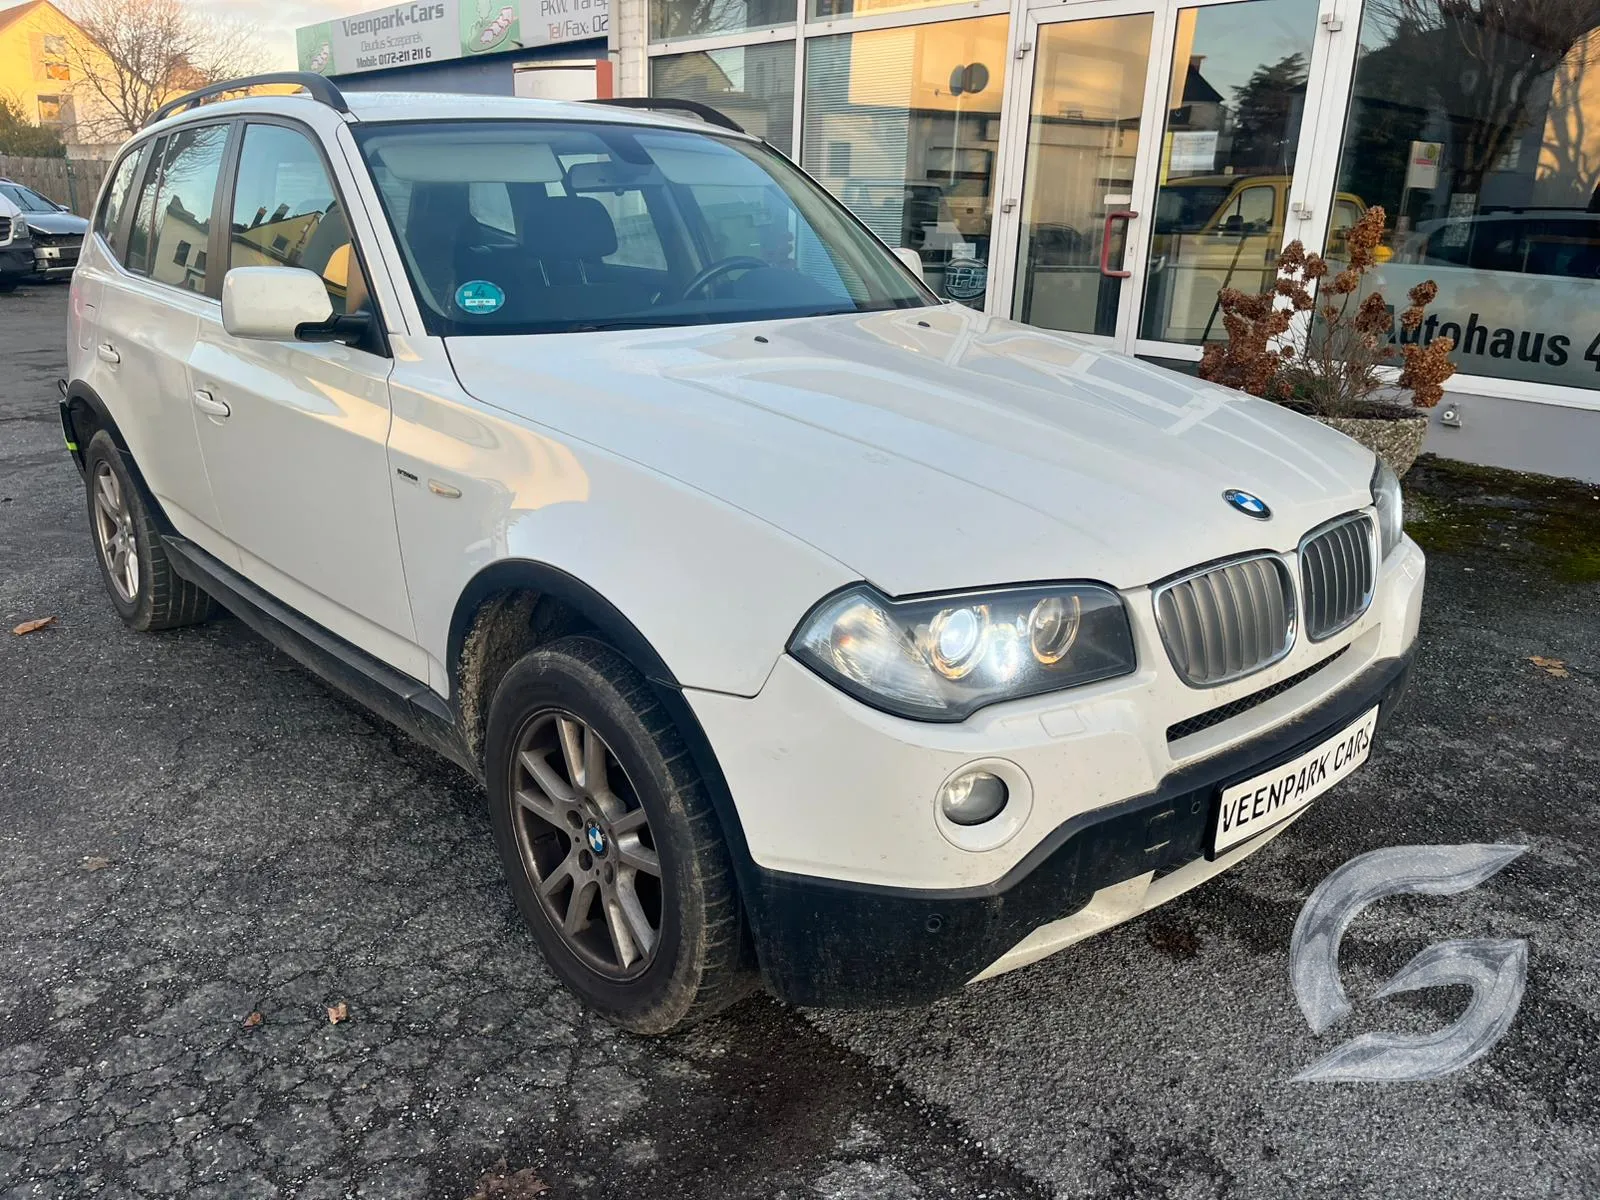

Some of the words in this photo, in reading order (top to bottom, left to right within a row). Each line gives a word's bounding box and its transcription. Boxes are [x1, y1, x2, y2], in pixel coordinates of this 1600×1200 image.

[412, 48, 424, 61] 211
[425, 46, 432, 58] 6
[1223, 751, 1332, 833] VEENPARK
[1333, 721, 1372, 771] CARS
